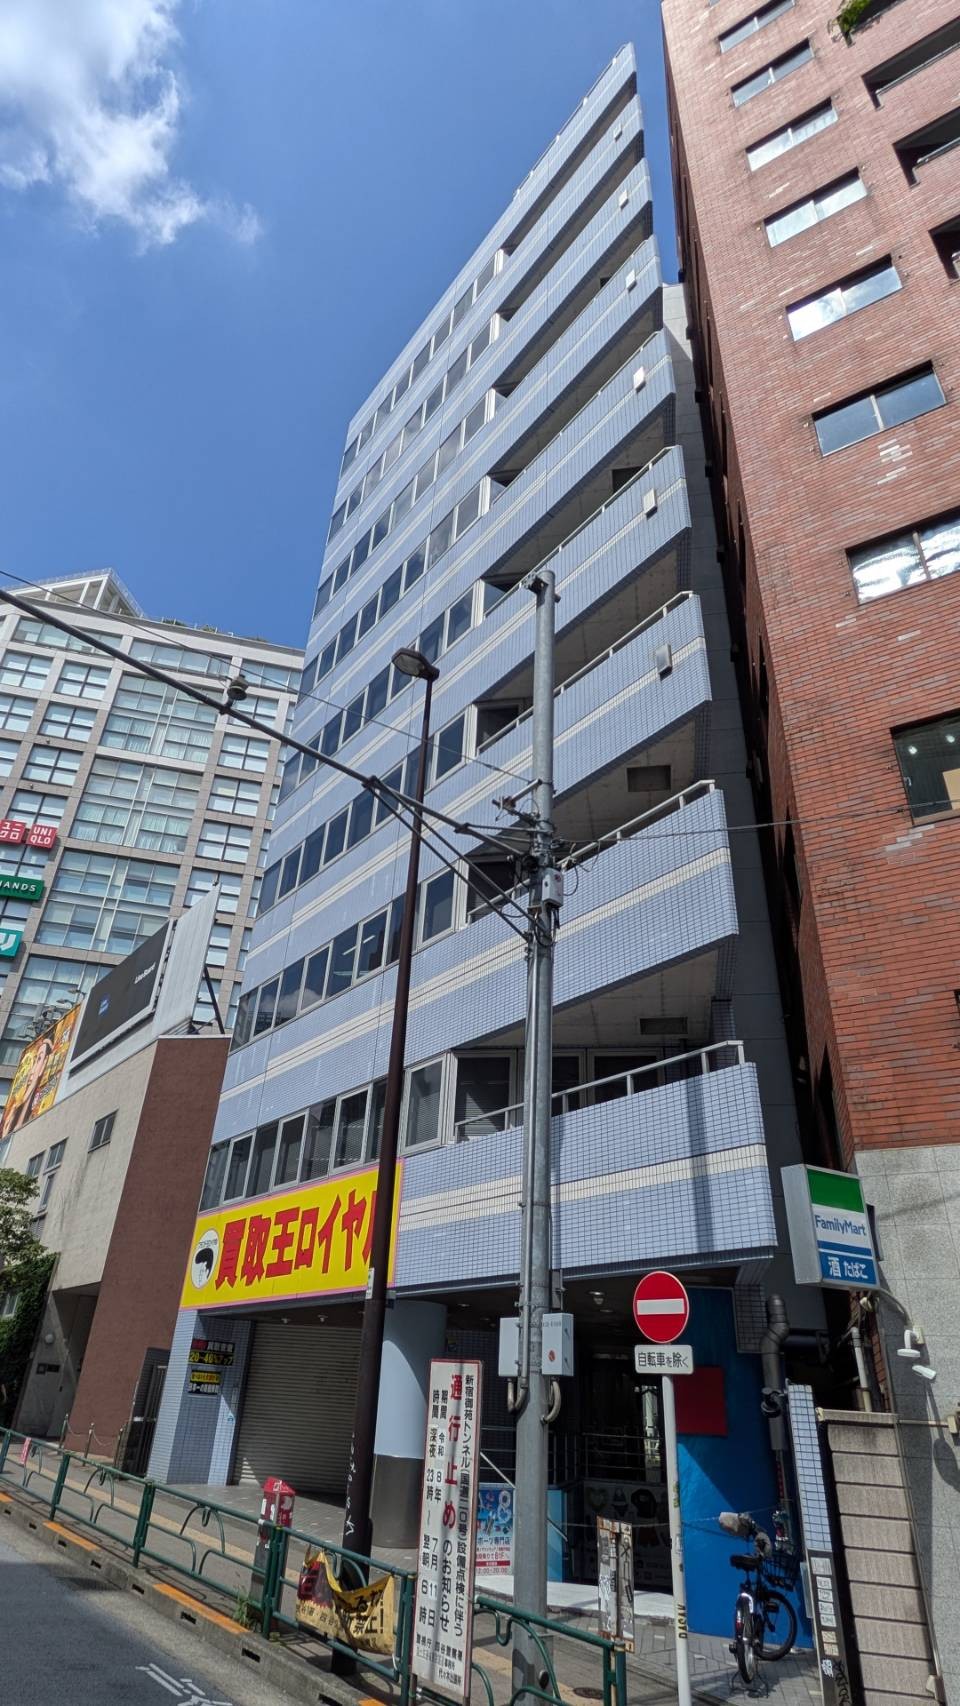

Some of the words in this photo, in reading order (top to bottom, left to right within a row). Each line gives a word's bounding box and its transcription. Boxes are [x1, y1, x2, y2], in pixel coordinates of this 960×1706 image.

[33, 825, 52, 836] UNI
[30, 836, 51, 845] QLO
[815, 1215, 867, 1236] FamilyMart
[828, 1256, 842, 1278] 酒
[843, 1260, 869, 1279] たばこ
[638, 1351, 689, 1368] 自転車を除く
